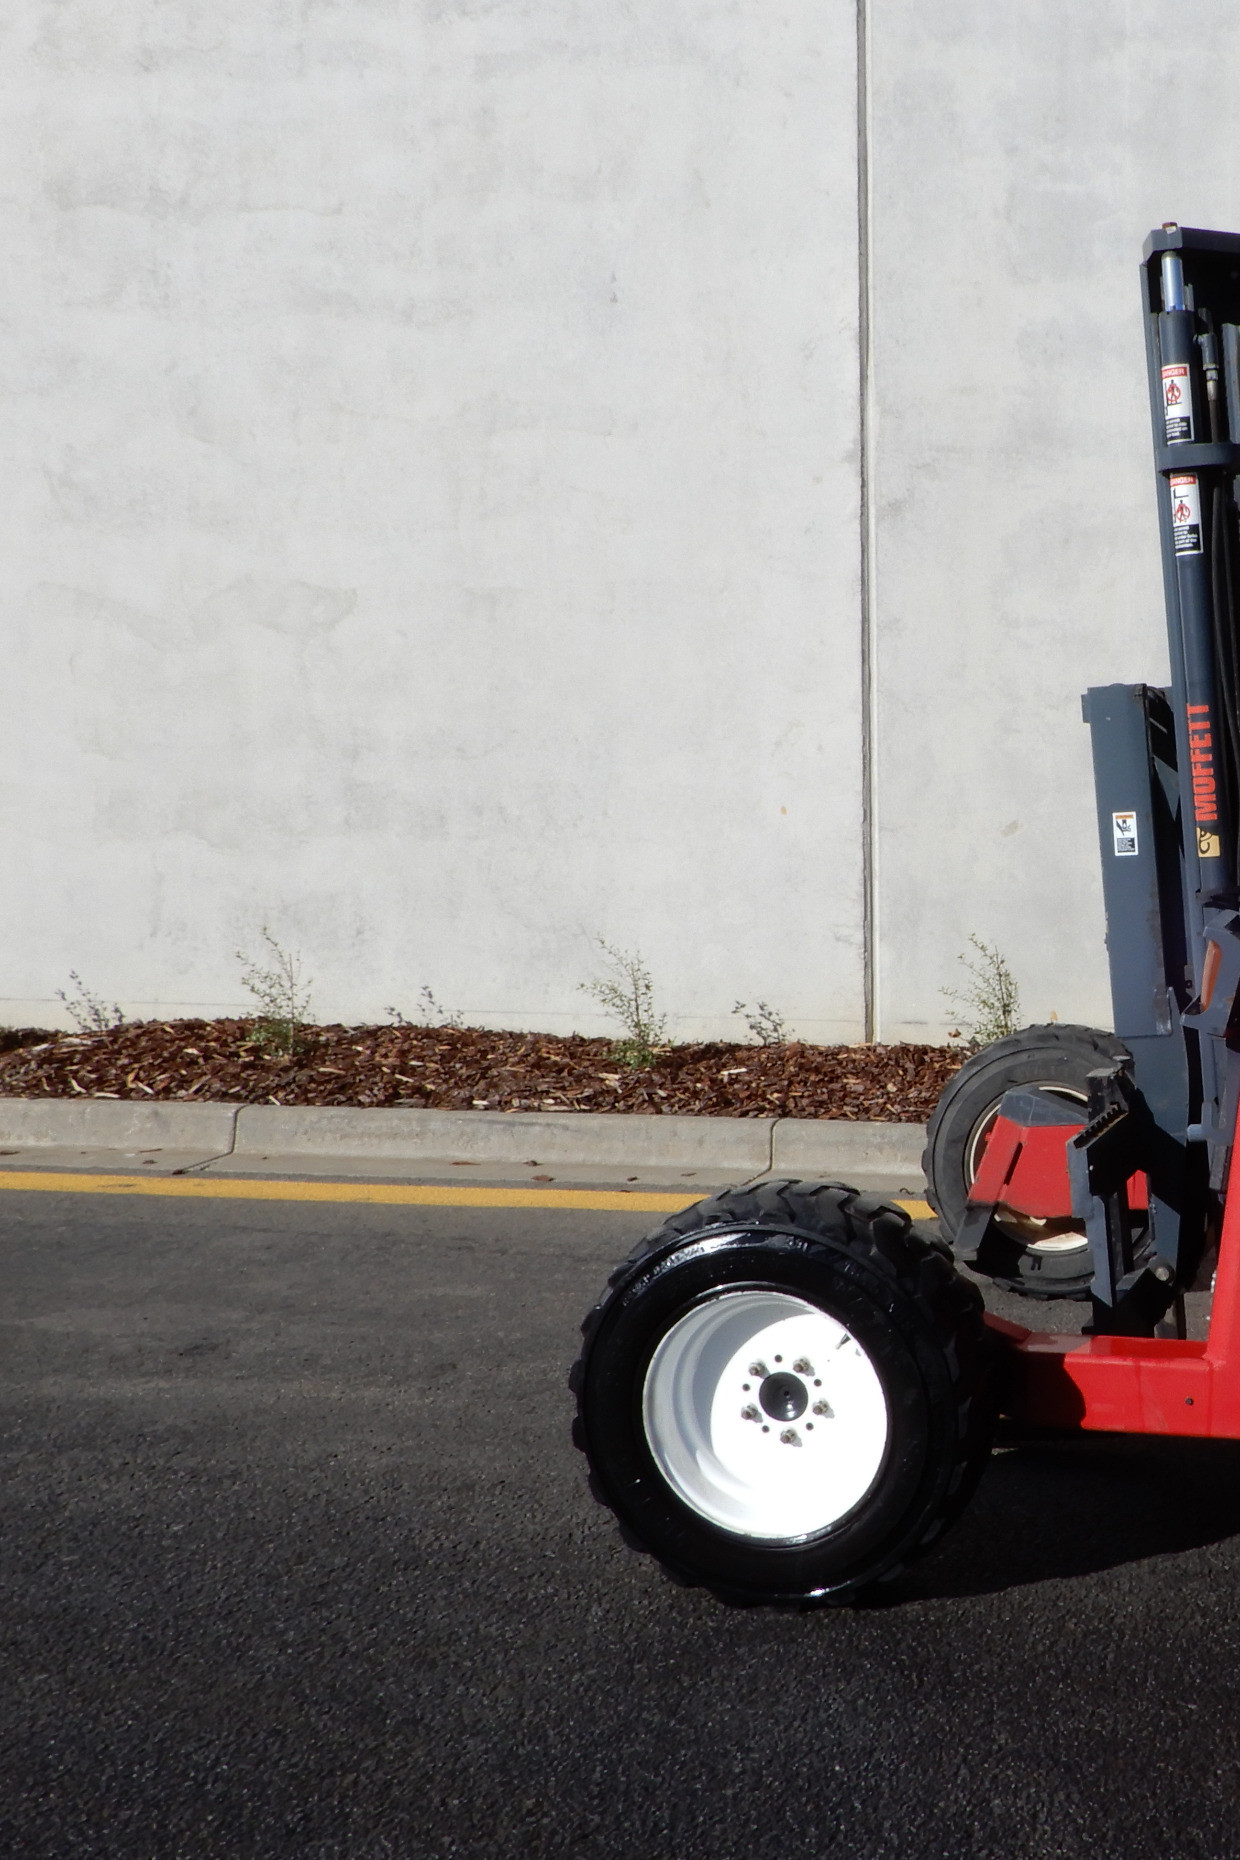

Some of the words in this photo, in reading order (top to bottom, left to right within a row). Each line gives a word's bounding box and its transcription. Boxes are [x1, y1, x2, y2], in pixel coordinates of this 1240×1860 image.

[1162, 368, 1185, 378] ANGER
[1170, 476, 1193, 486] ANGER
[1186, 703, 1218, 821] MOFFETT
